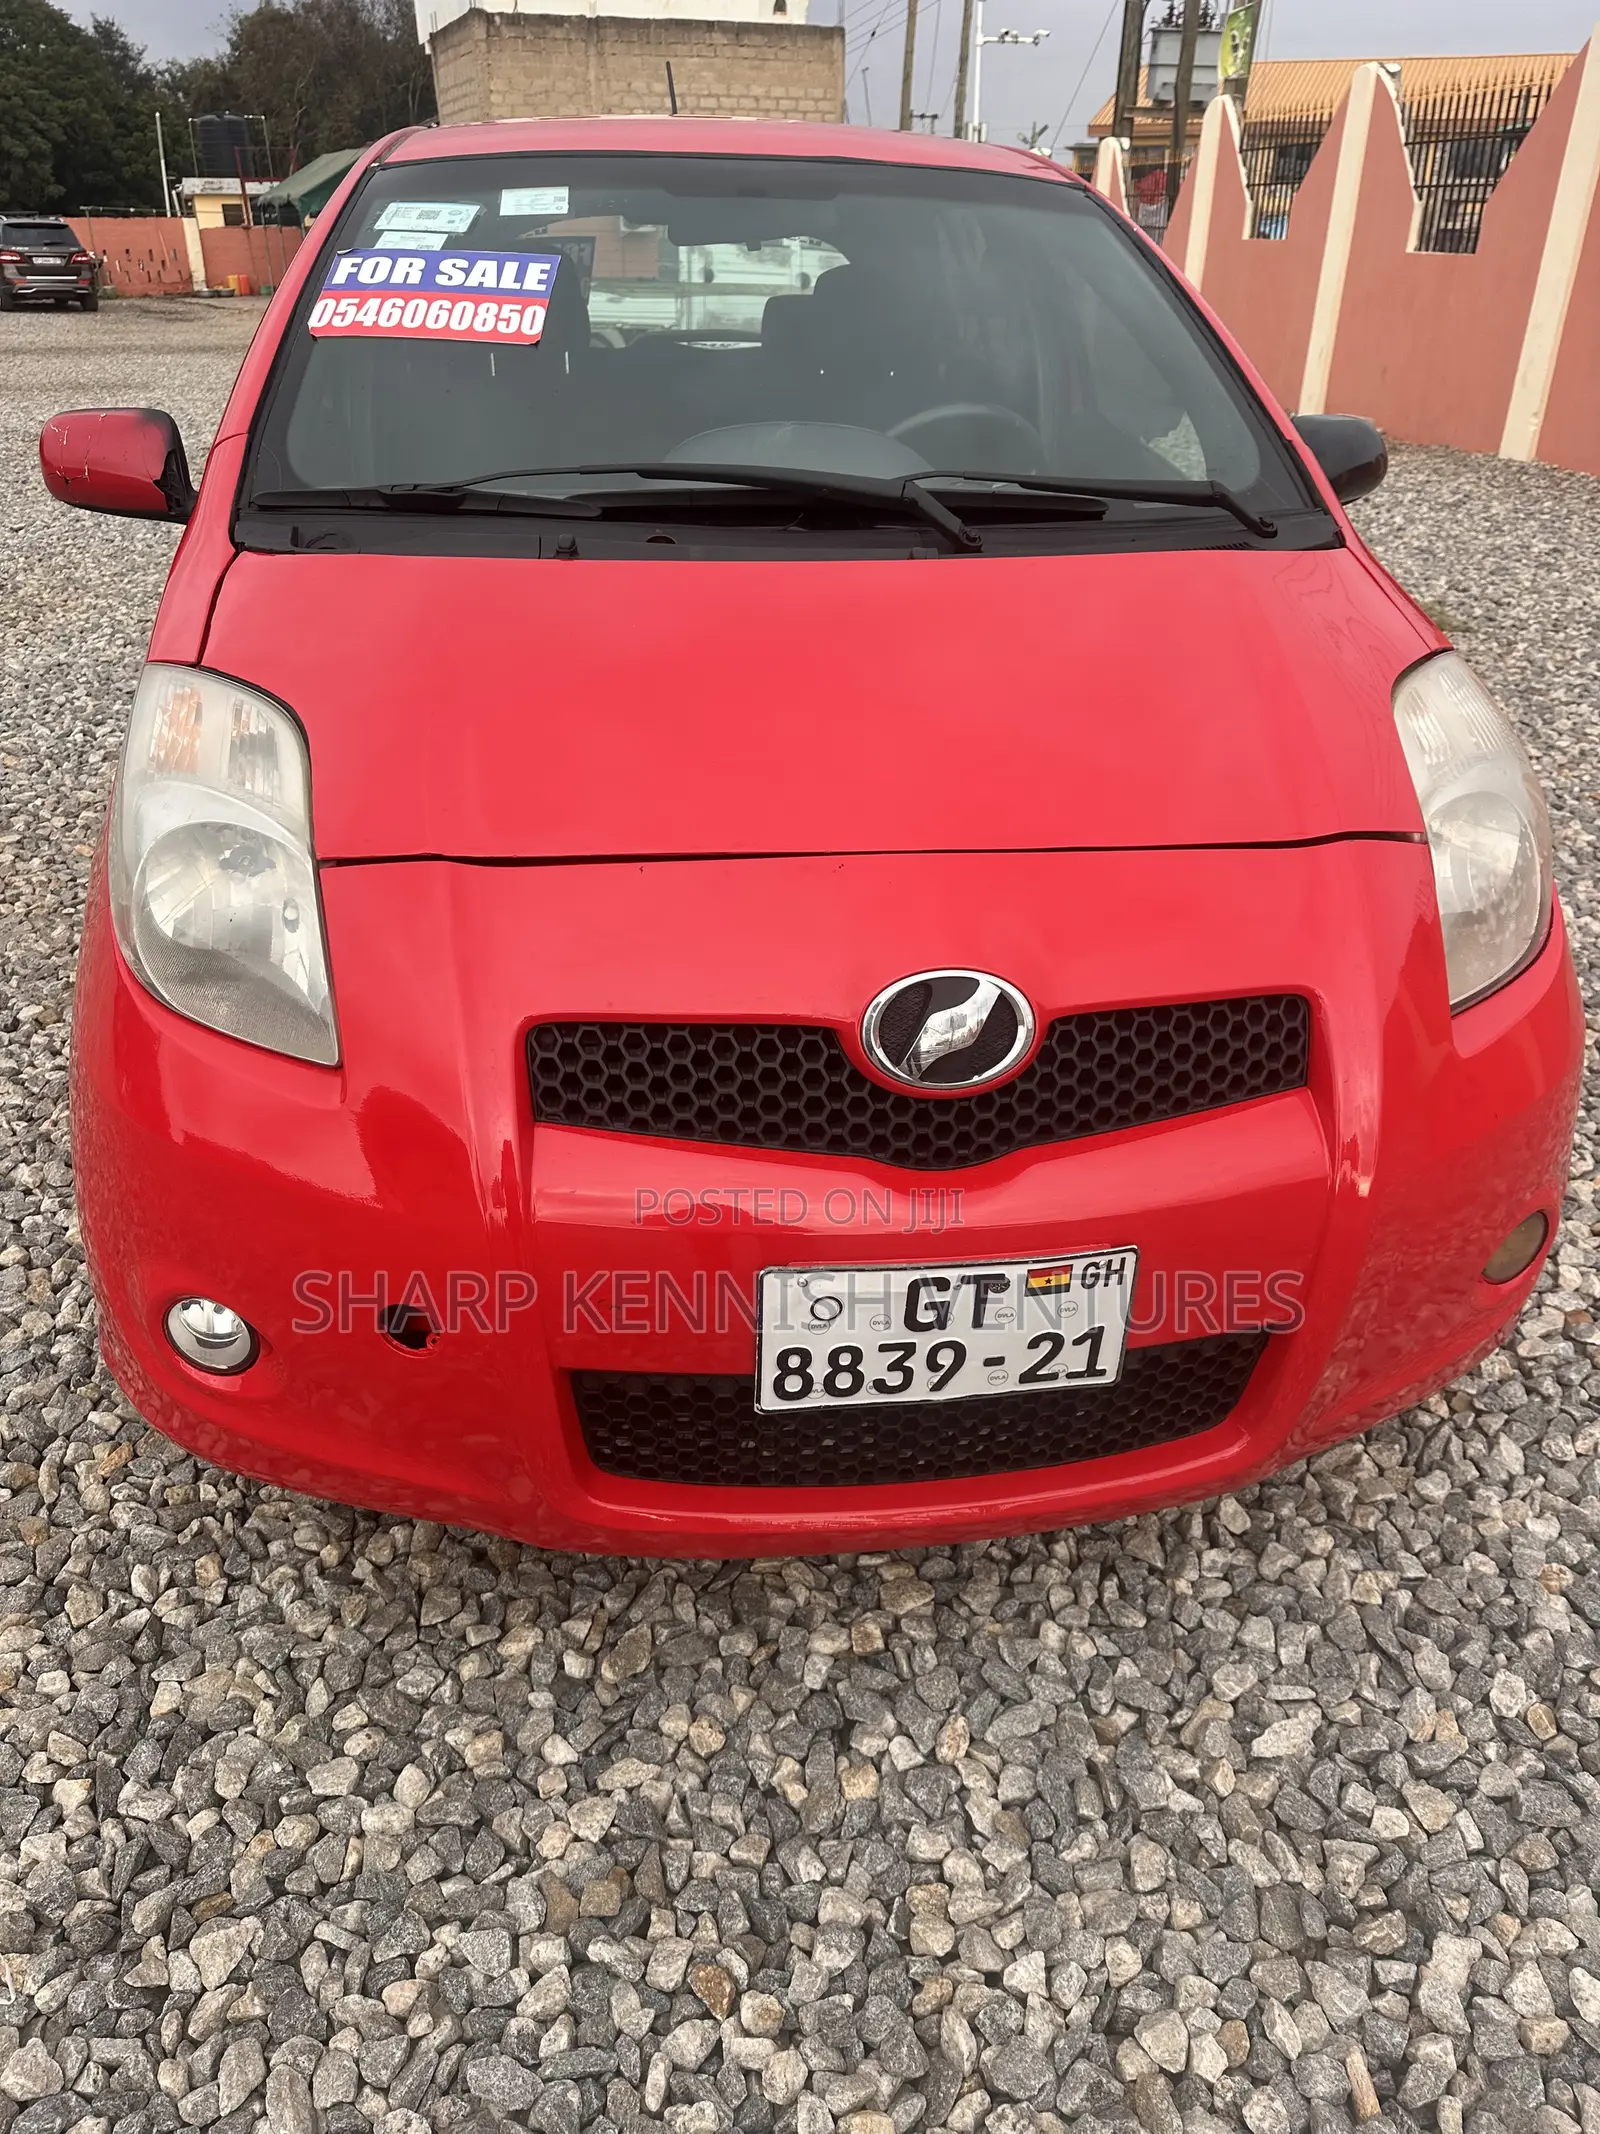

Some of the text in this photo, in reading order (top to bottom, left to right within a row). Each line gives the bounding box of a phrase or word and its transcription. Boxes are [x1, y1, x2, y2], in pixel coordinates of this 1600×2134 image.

[331, 256, 427, 285] FOR
[434, 257, 552, 292] SALE
[310, 297, 547, 336] 0546060850
[903, 1257, 1127, 1333] GT GH
[997, 1311, 1015, 1319] DVLA
[772, 1325, 1107, 1401] 8839-21
[989, 1374, 1006, 1382] DVLA
